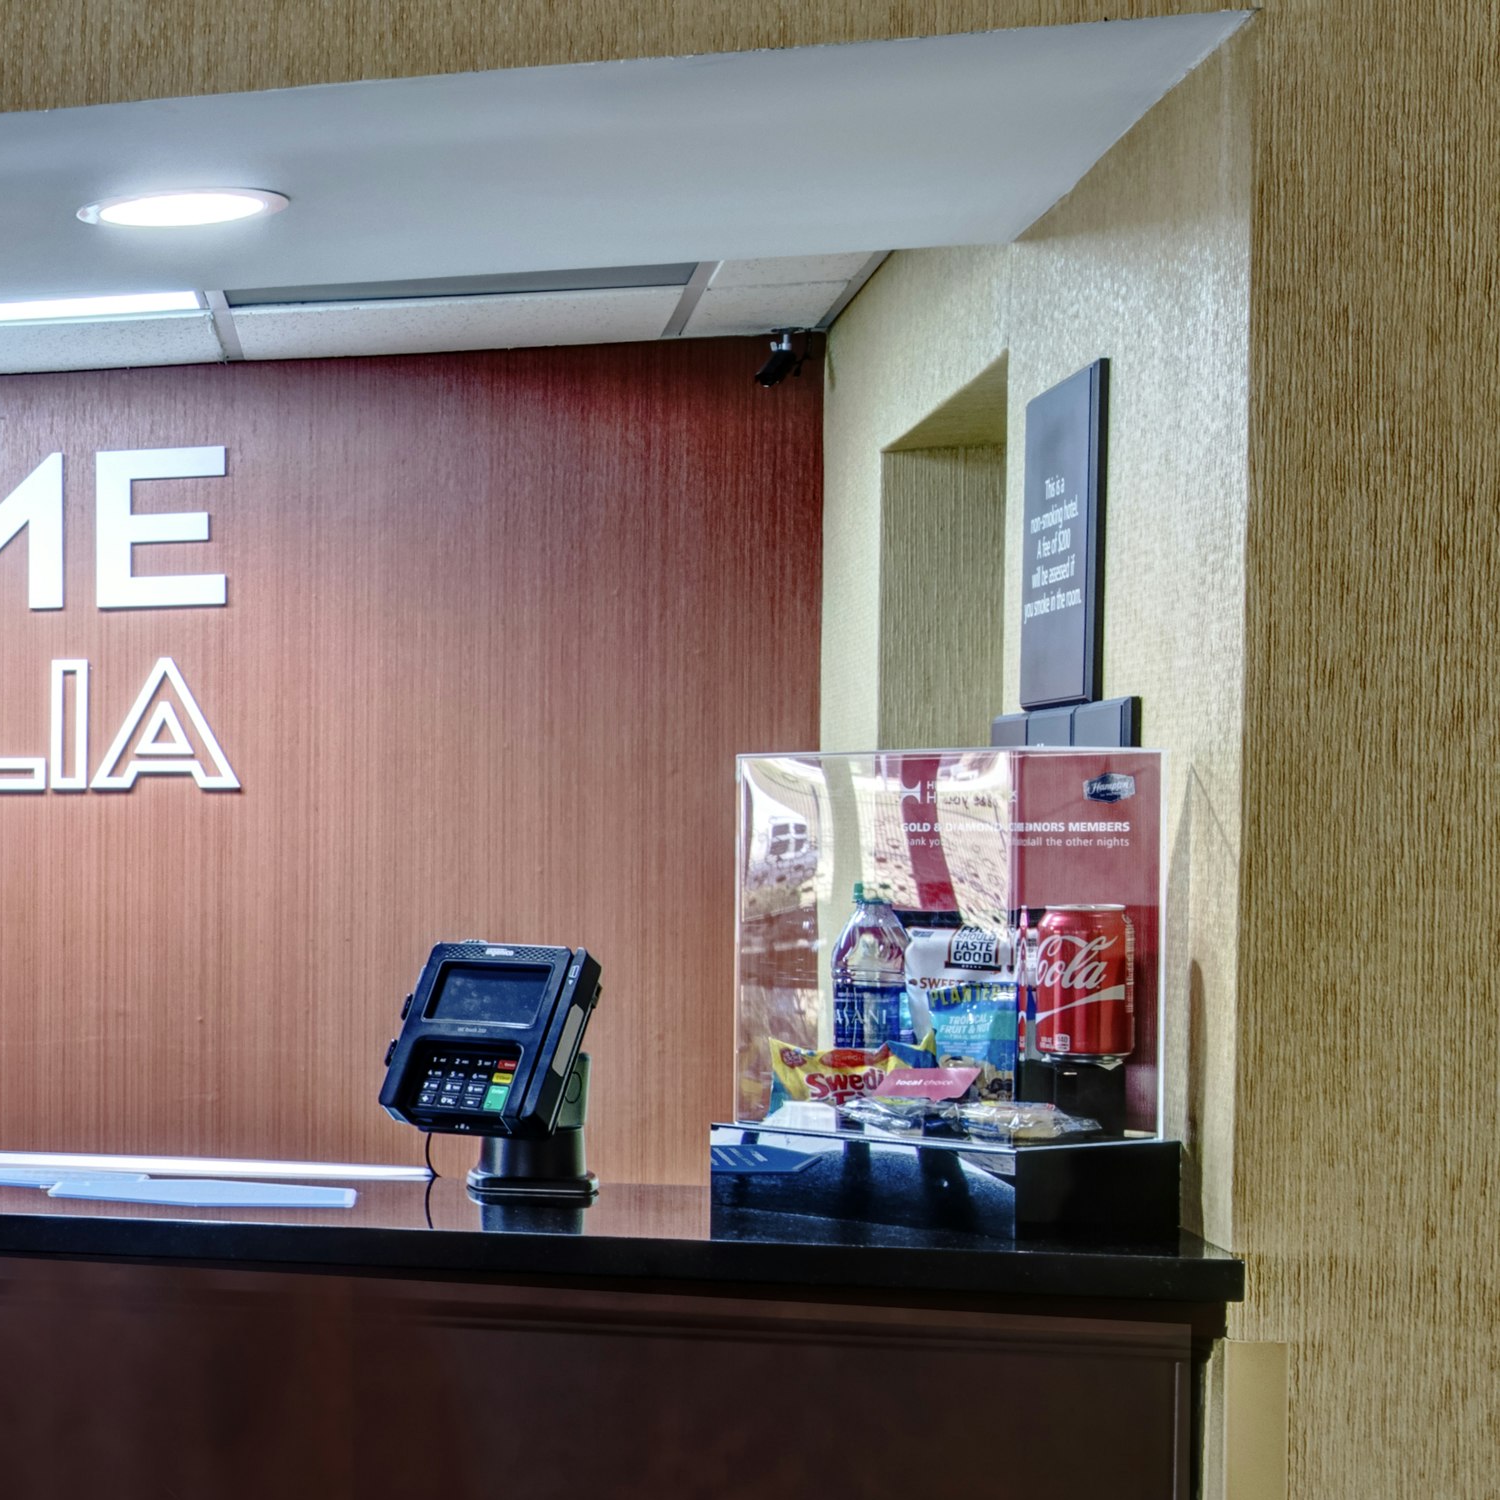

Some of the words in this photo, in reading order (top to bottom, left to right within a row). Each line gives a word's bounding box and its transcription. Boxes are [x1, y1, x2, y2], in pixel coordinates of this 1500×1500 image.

[1045, 476, 1055, 500] This
[1030, 504, 1063, 535] non-smoking
[1036, 539, 1042, 560] A
[1042, 536, 1051, 558] fee
[1051, 531, 1058, 554] of
[1031, 564, 1041, 589] will
[1041, 564, 1048, 586] be
[1049, 556, 1070, 584] assessed
[1023, 603, 1033, 625] you
[1034, 592, 1050, 617] smoke
[1056, 587, 1066, 610] the
[901, 822, 931, 832] GOLD
[1069, 822, 1131, 832] MEMBERS
[1046, 837, 1063, 846] the
[1066, 837, 1093, 846] other
[1096, 837, 1130, 848] nights
[954, 940, 994, 952] TASTE
[956, 932, 997, 942] SHOULD
[953, 951, 993, 963] GOOD
[1036, 934, 1118, 990] Cola
[940, 1024, 968, 1034] FRUIT
[976, 1023, 991, 1033] NUT
[805, 1069, 885, 1101] Swedi
